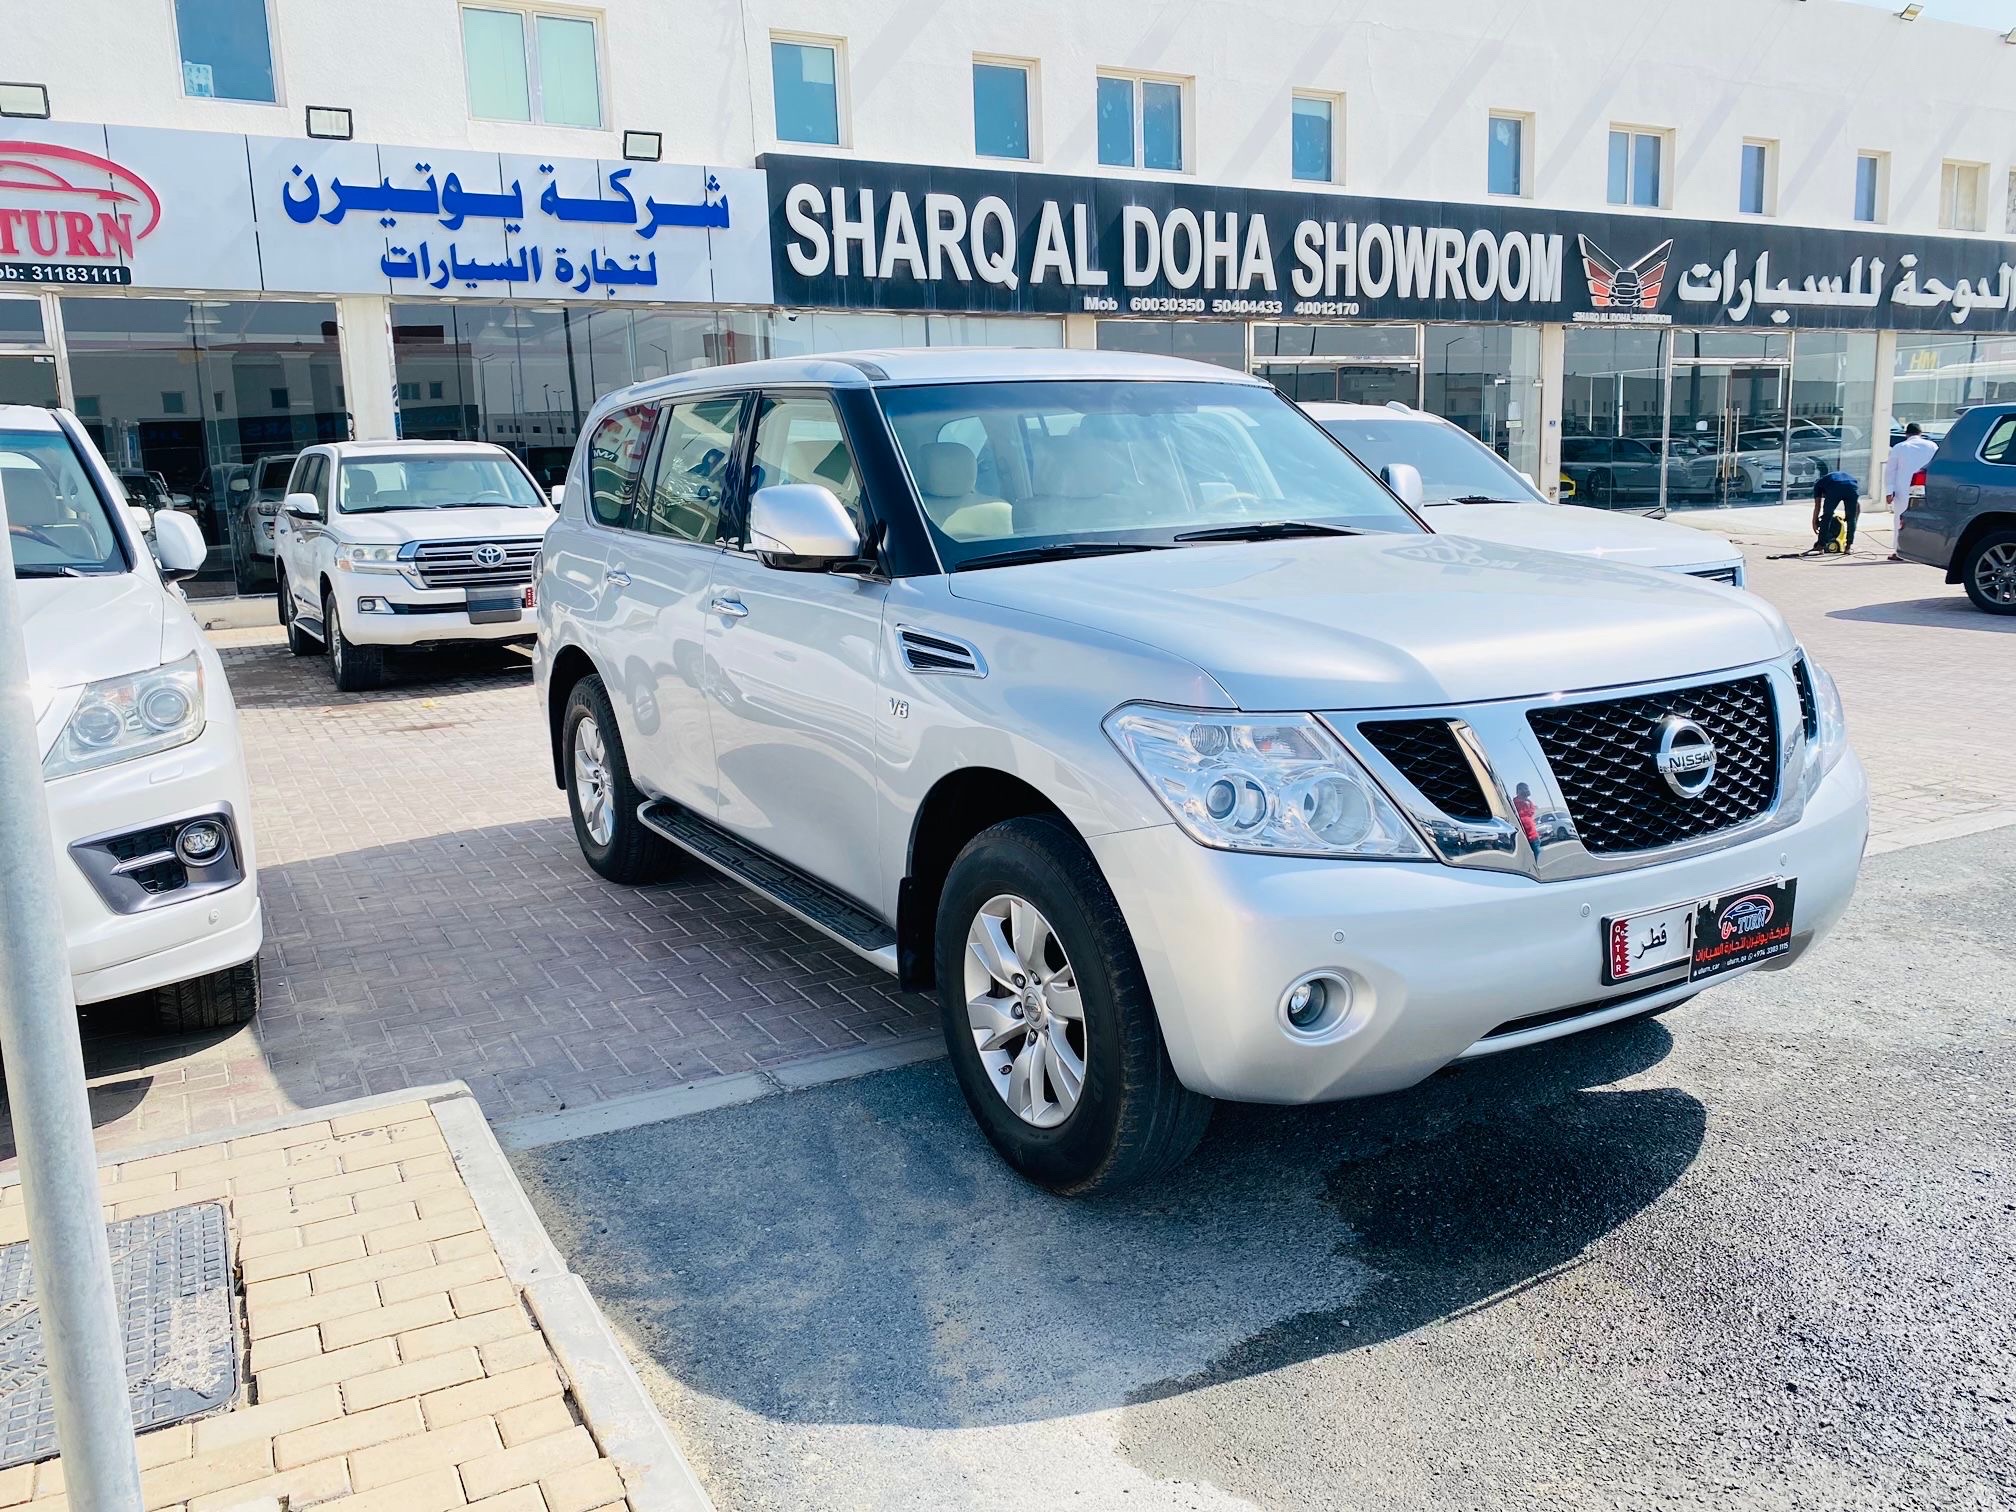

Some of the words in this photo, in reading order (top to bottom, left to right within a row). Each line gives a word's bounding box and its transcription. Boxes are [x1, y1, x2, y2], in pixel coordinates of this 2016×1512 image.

[282, 162, 525, 235] يوتيرن
[539, 163, 731, 240] شركة
[380, 241, 543, 290] السيارات
[784, 183, 1020, 291] SHARQ
[1030, 201, 1108, 286] AL
[1122, 205, 1278, 291] DOHA
[1291, 219, 1564, 303] SHOWROOM
[31, 265, 122, 283] 31183111
[554, 246, 658, 296] لتجارة
[1677, 248, 1886, 323] للسيارات
[1083, 296, 1119, 311] Mob
[1129, 296, 1206, 313] 60030350
[1211, 299, 1283, 314] 50404433
[1293, 301, 1360, 315] 40012170
[889, 697, 909, 719] V8
[1668, 750, 1716, 769] NISSAN
[1614, 925, 1622, 973] QATAR
[1634, 922, 1668, 960] قطر
